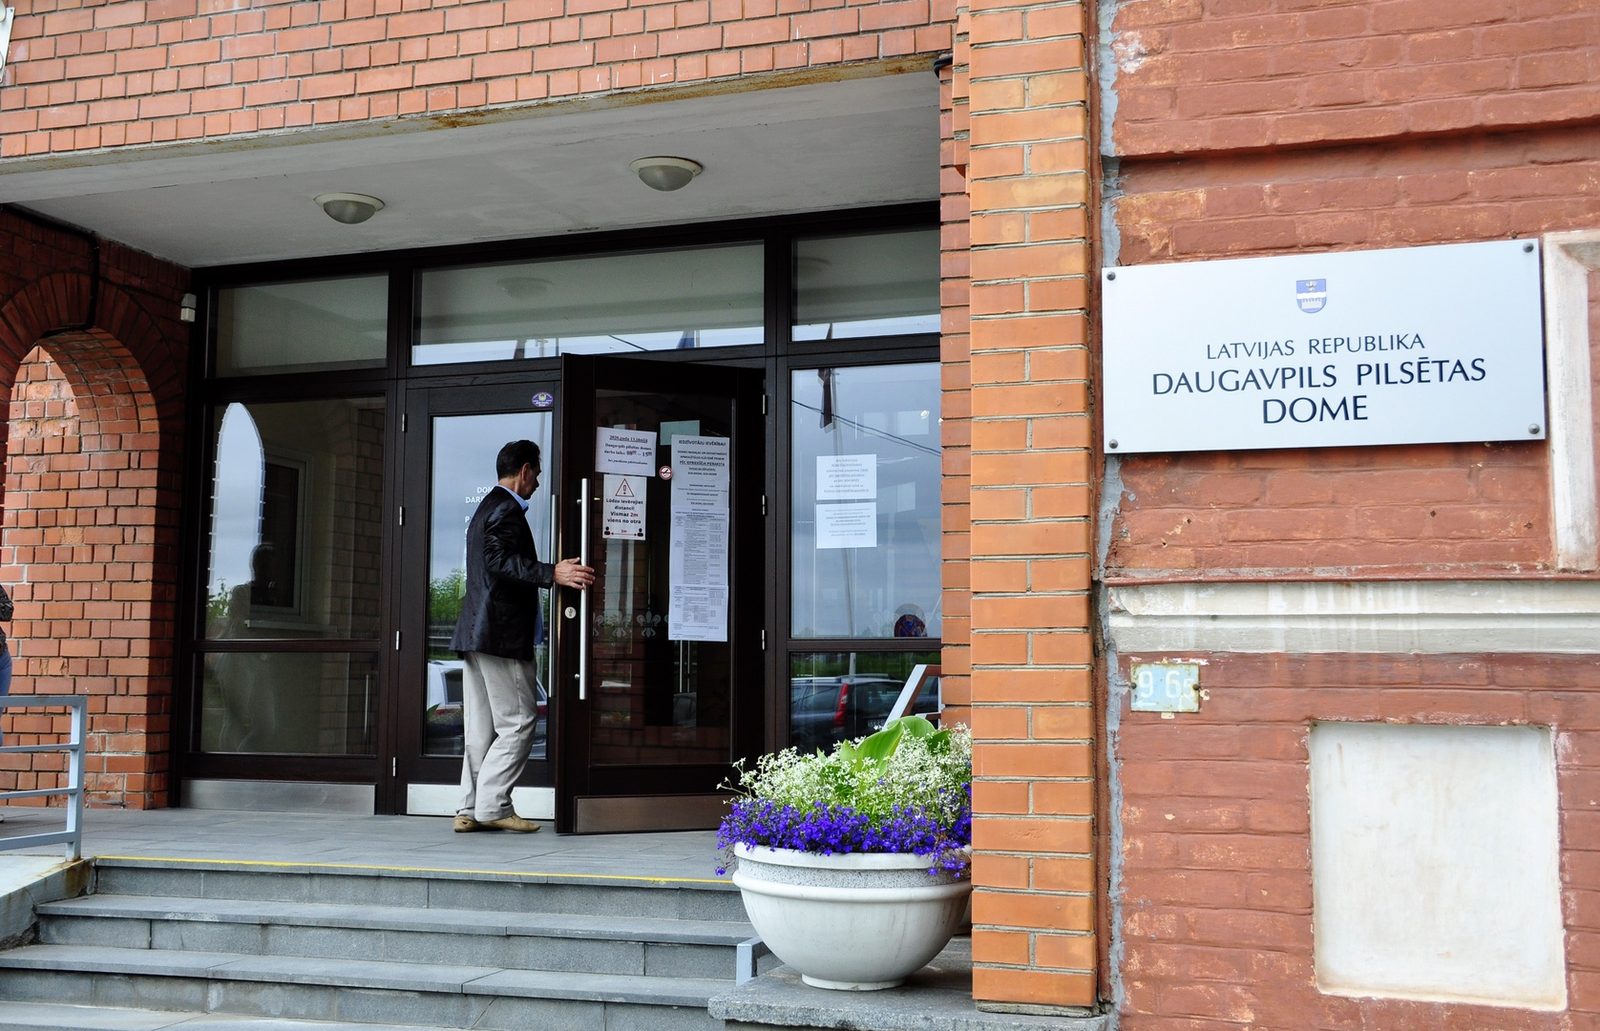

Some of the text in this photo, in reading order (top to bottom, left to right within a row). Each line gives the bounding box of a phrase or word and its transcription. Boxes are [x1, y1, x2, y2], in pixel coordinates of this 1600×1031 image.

[1207, 333, 1425, 360] LATVIJAS REPUBLIKA
[1153, 356, 1486, 395] DAUGAVPILS PILSĒTAS
[1263, 394, 1369, 424] DOME
